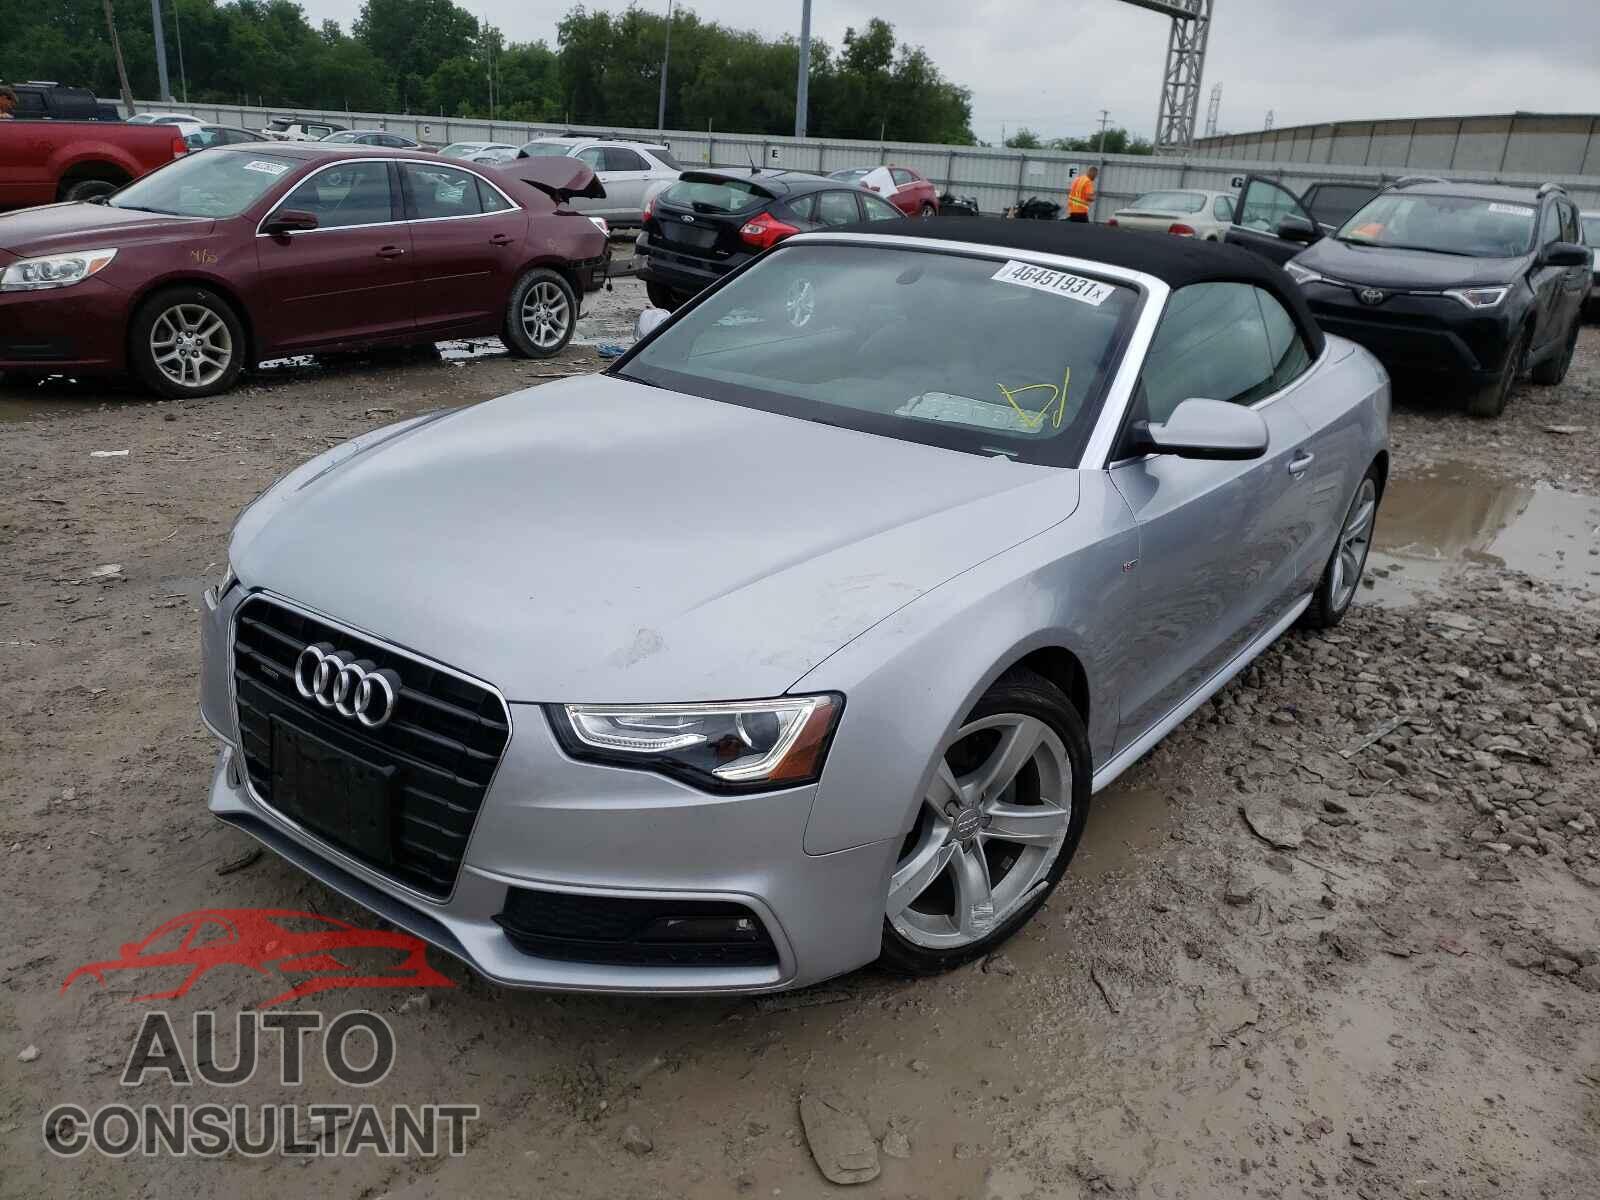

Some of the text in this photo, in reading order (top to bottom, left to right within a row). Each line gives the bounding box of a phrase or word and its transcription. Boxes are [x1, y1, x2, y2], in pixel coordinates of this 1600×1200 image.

[424, 126, 431, 134] C
[771, 149, 779, 159] E
[1068, 167, 1078, 178] F
